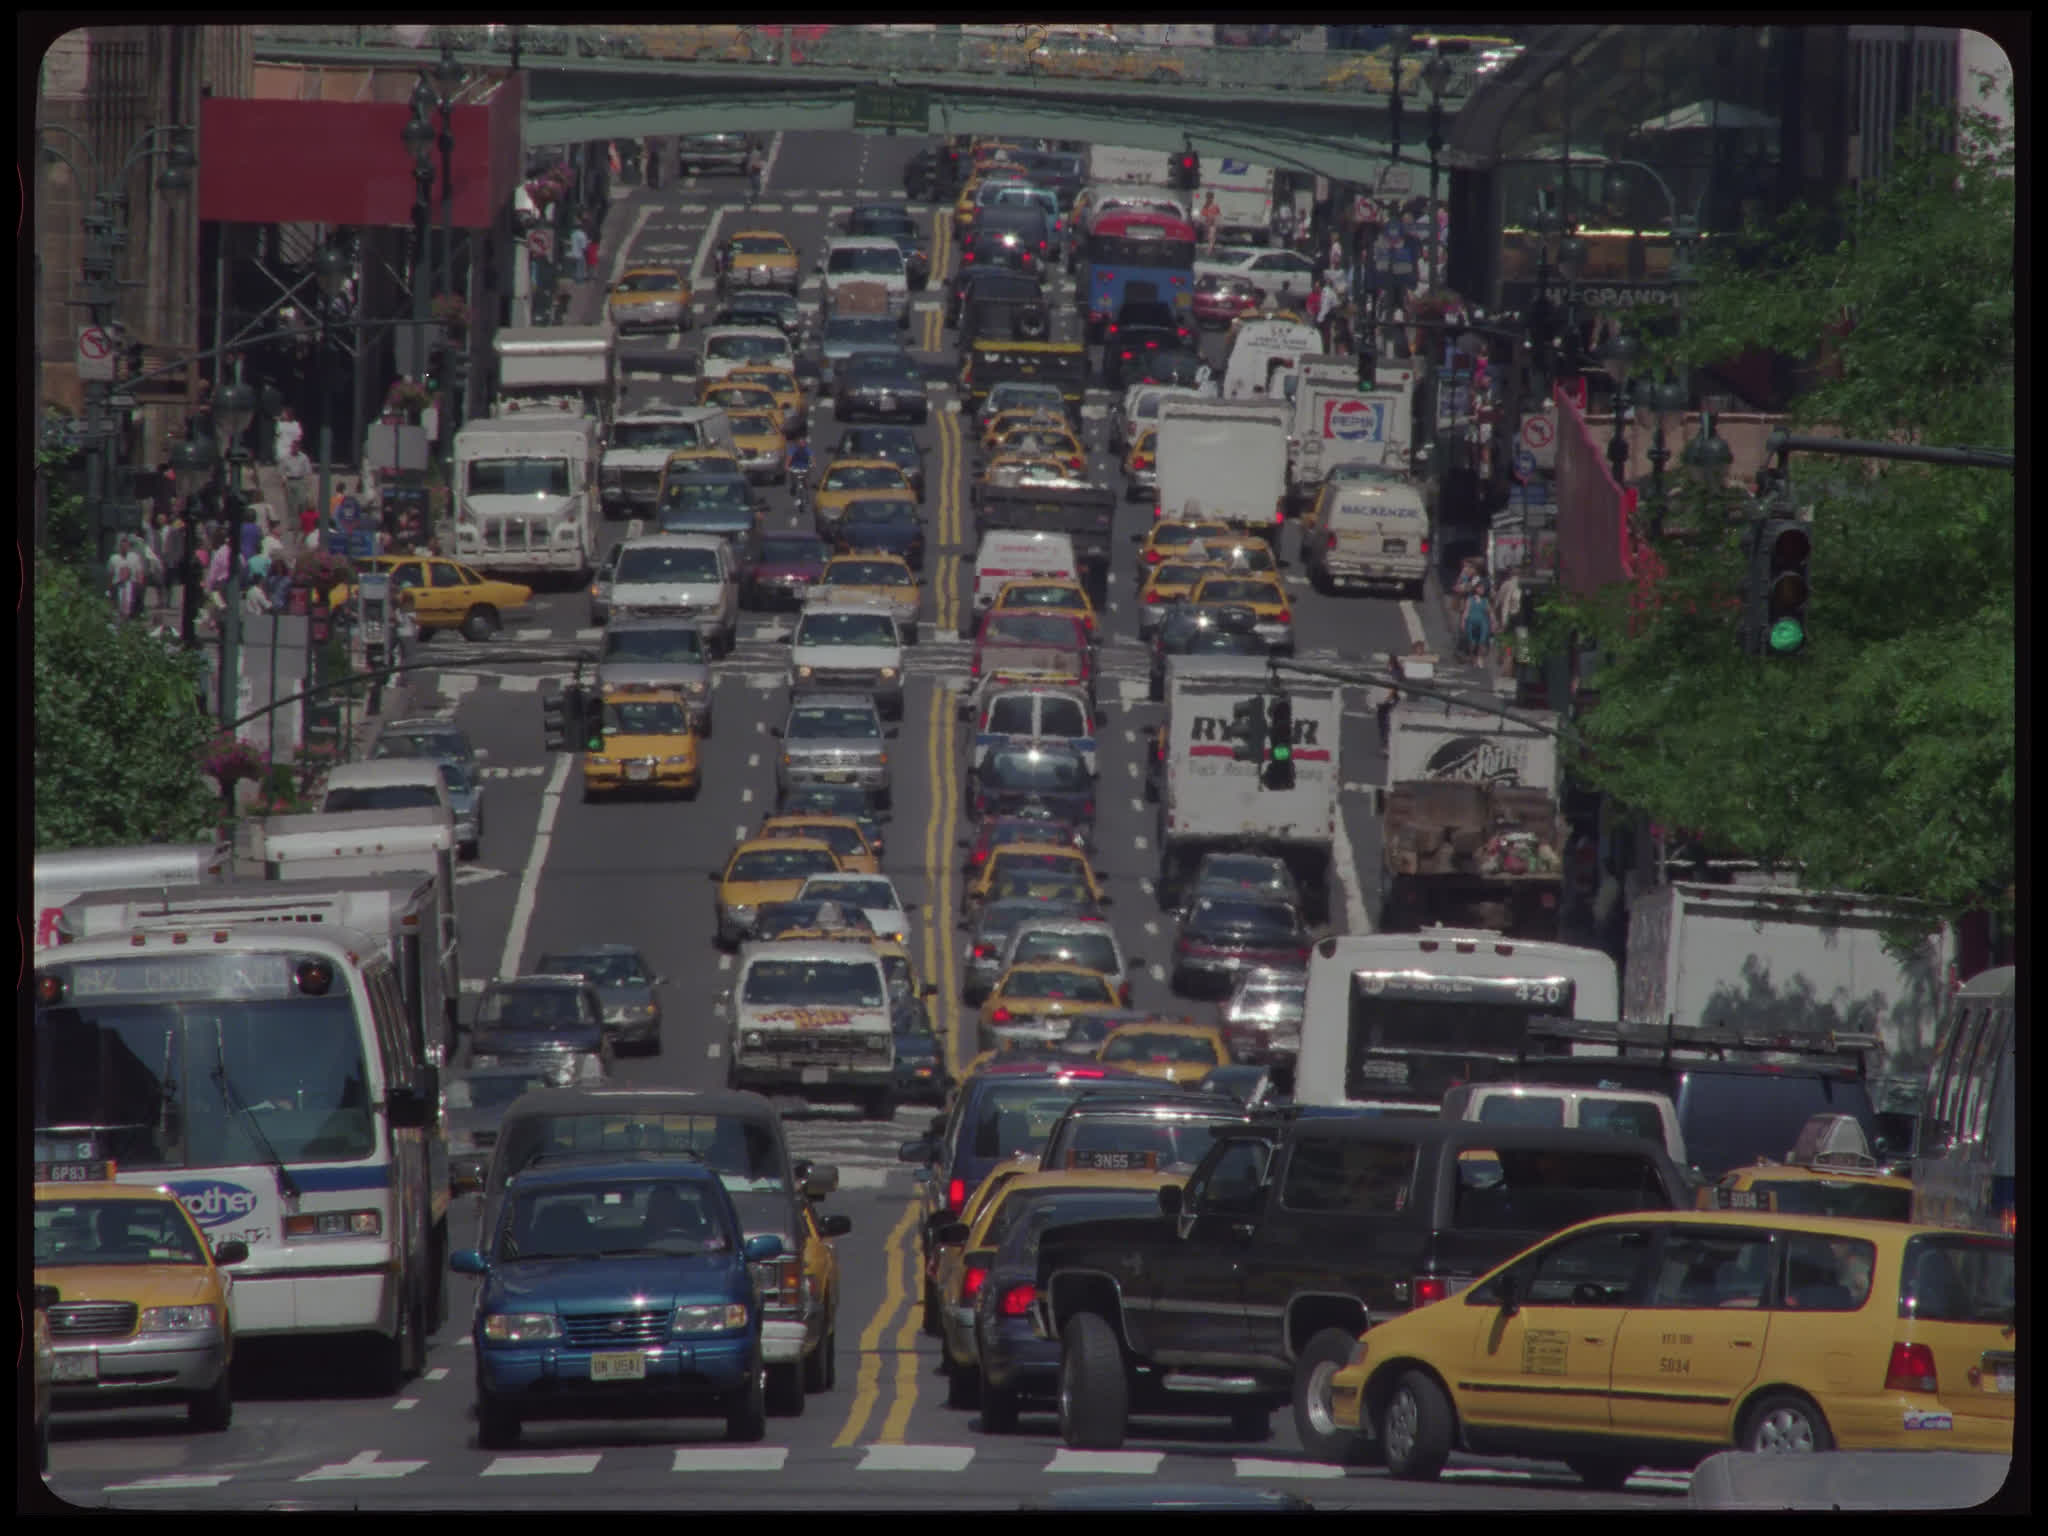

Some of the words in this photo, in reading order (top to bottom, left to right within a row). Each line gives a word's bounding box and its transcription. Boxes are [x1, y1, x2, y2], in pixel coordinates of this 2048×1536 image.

[1191, 716, 1319, 745] RYR
[1515, 985, 1561, 1002] 420
[1093, 1153, 1129, 1169] 3N55
[179, 1186, 256, 1214] rother
